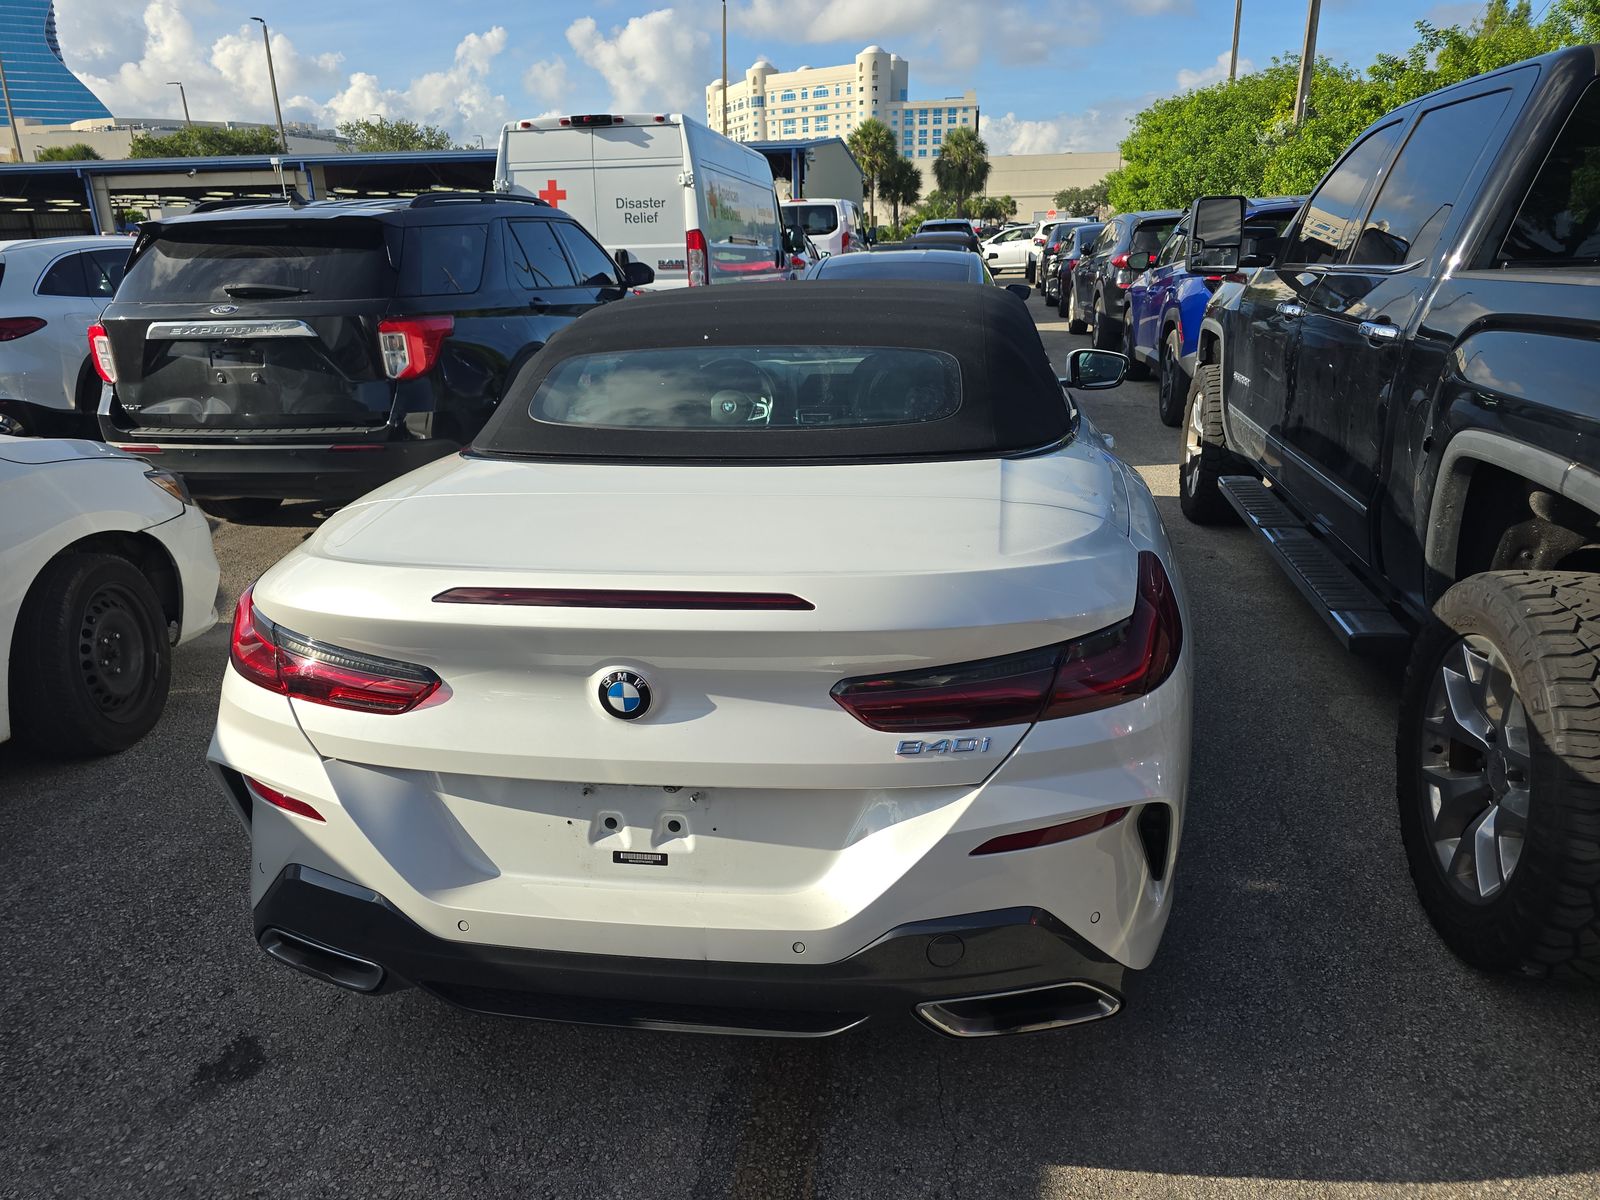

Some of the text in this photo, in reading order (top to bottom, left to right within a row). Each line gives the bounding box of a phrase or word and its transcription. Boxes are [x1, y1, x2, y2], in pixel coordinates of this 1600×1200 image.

[615, 197, 666, 209] Disaster
[624, 211, 658, 224] Relief
[895, 737, 991, 754] 840i
